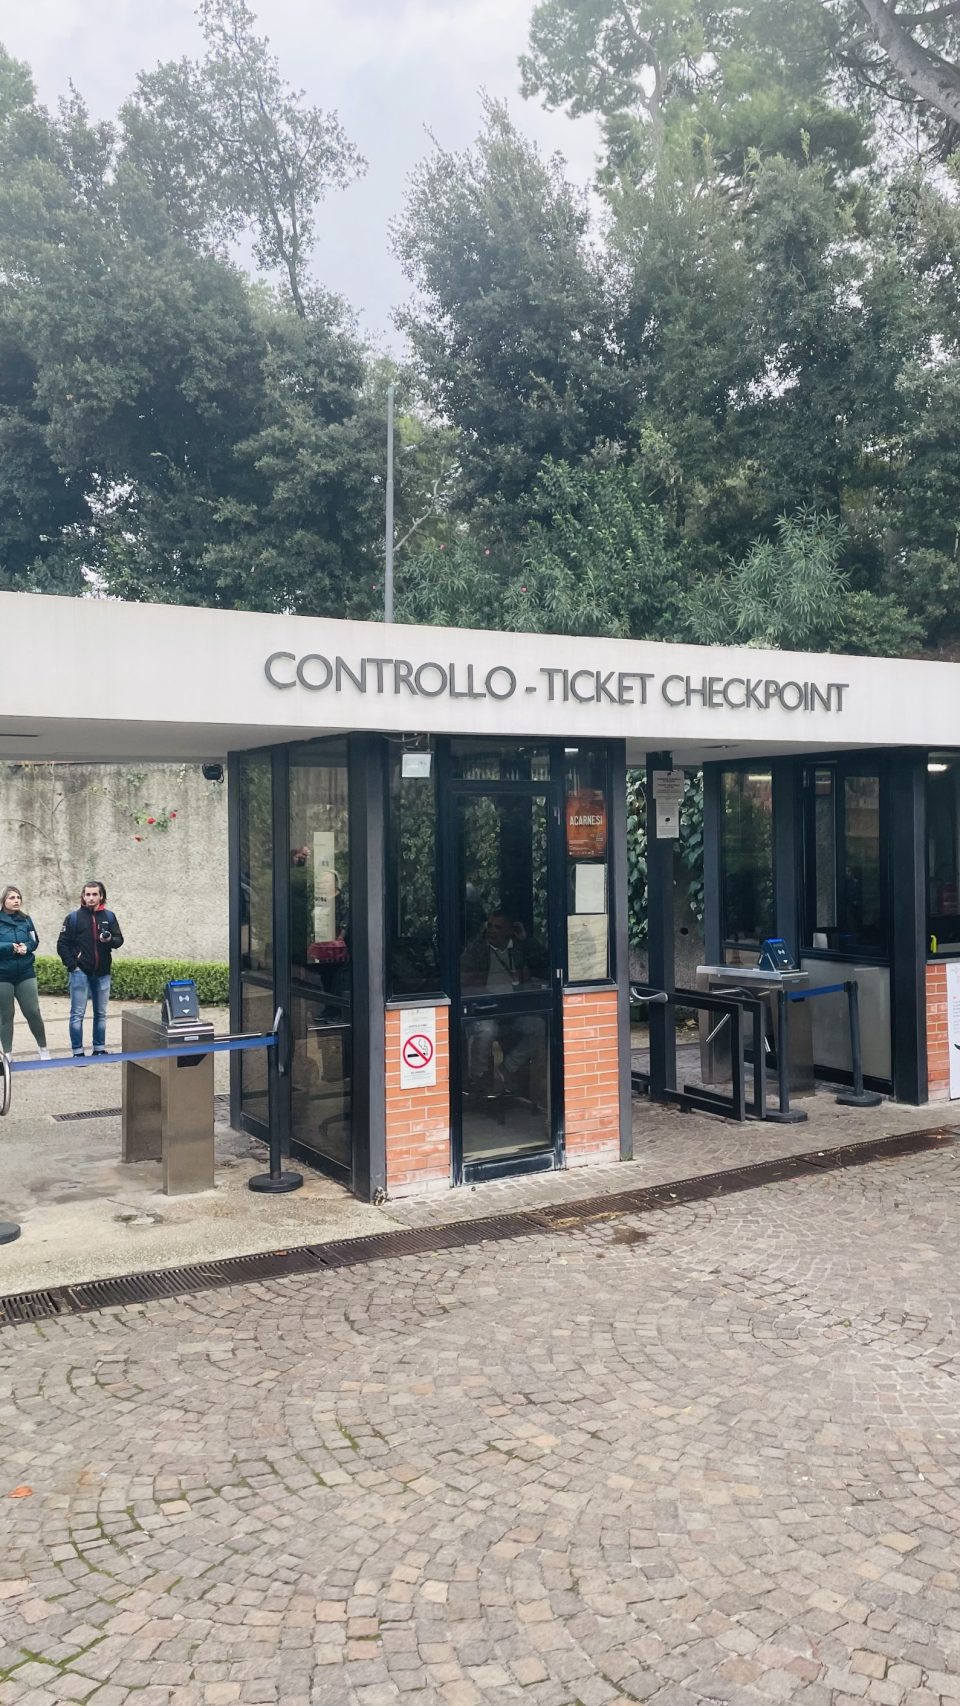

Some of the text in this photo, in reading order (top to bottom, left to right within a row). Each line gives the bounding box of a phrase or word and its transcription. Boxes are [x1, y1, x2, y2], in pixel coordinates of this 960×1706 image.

[264, 651, 517, 700] CONTROLLO
[540, 667, 655, 704] TICKET
[662, 674, 850, 711] CHECKPOINT
[569, 815, 603, 826] ACARNESI
